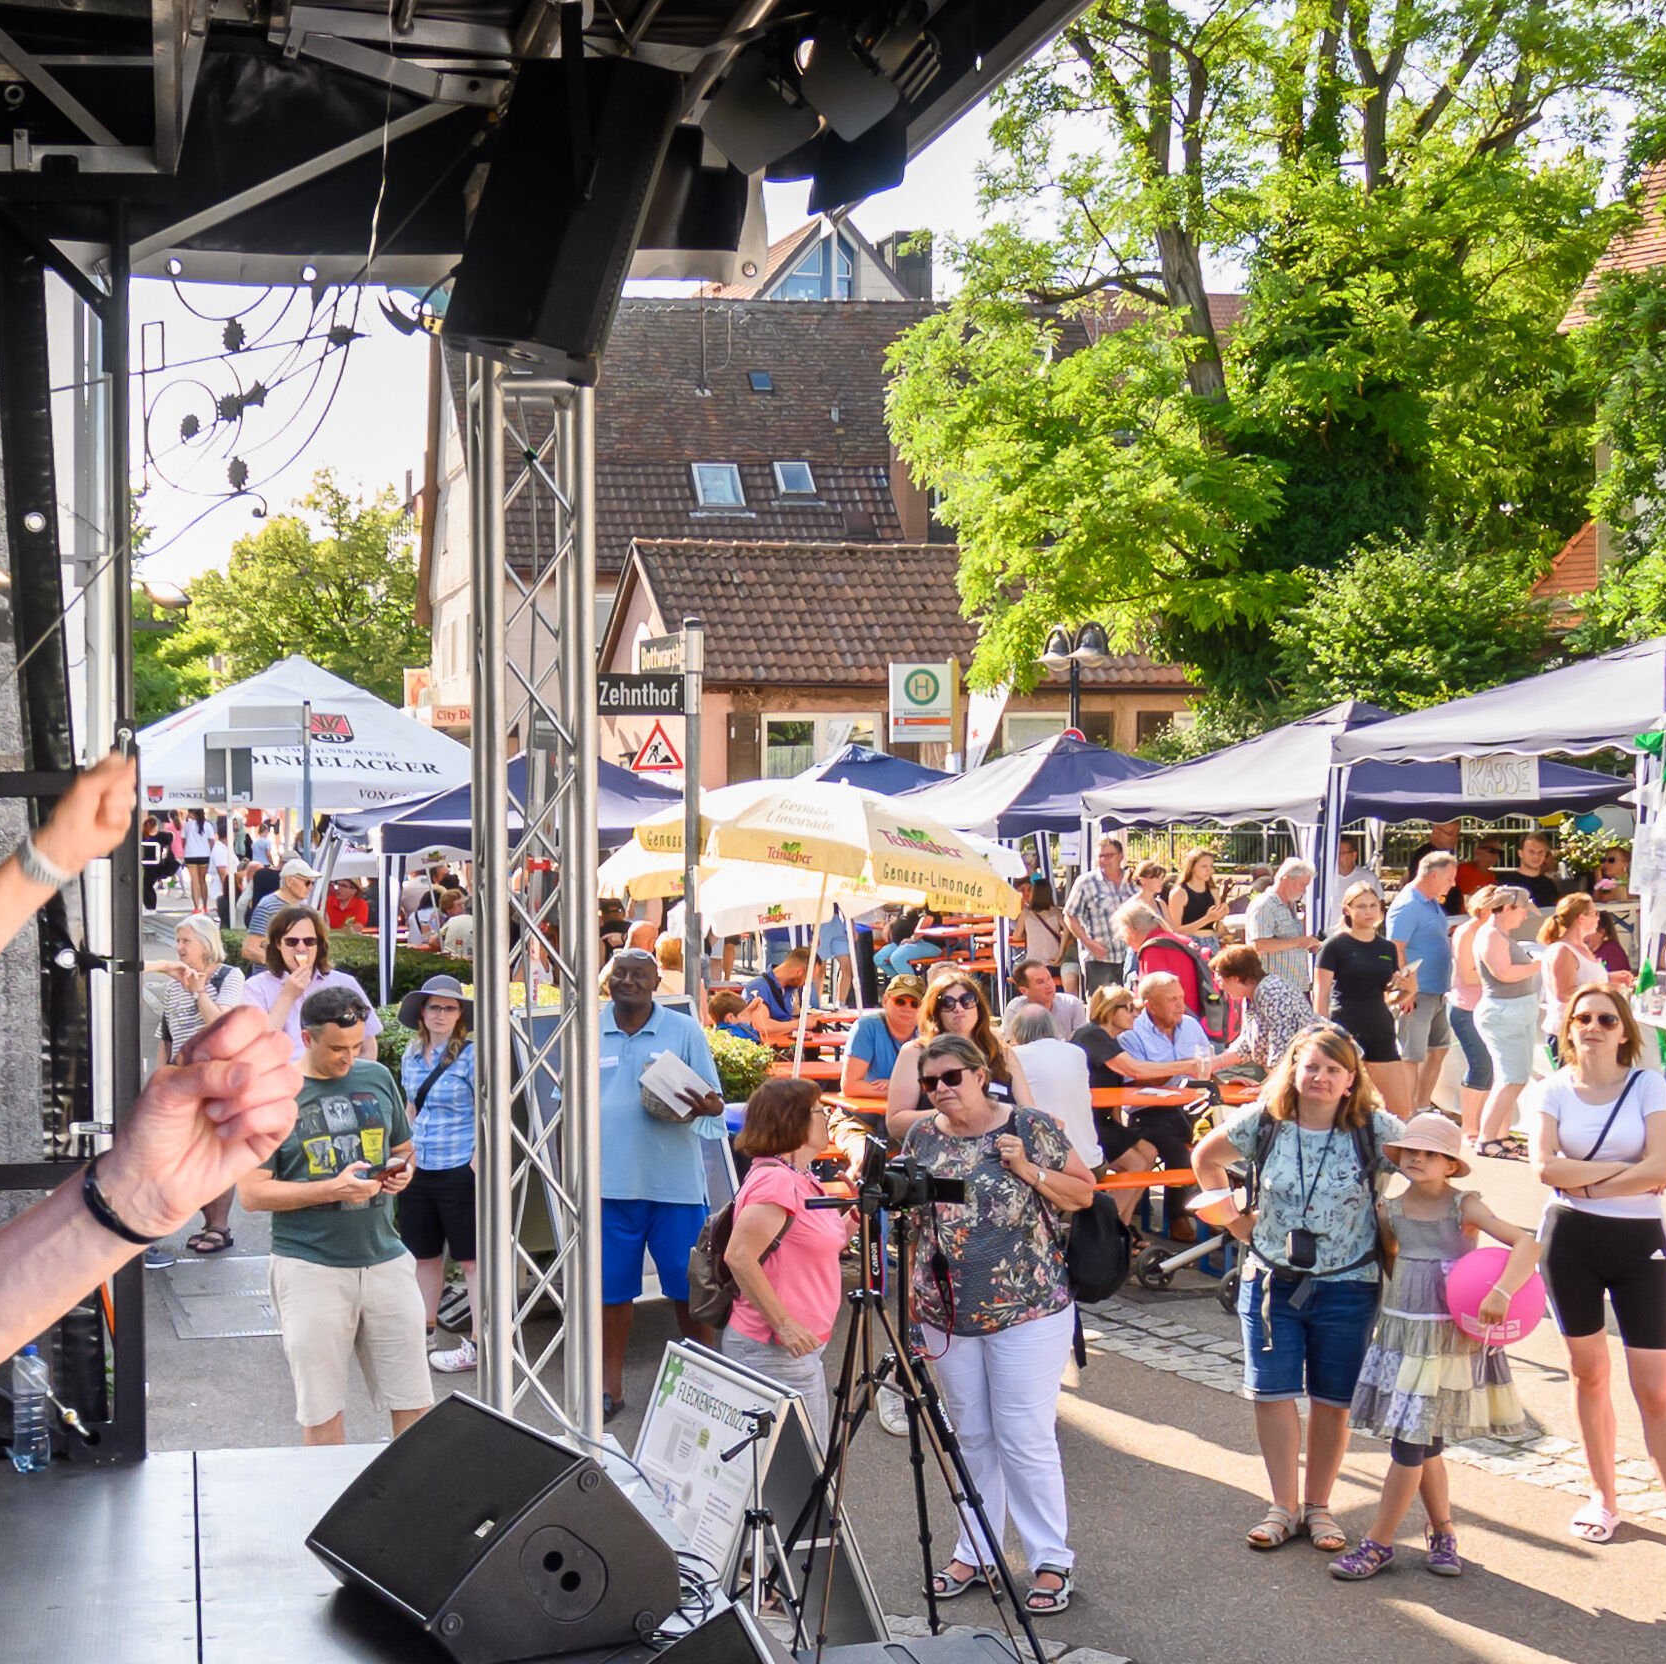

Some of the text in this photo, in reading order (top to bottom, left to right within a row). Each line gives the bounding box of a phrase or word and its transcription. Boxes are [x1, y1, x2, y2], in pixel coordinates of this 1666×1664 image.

[598, 680, 678, 707] Zehnthof
[436, 709, 456, 722] City
[1468, 758, 1532, 798] KASSE
[883, 861, 983, 897] Genuss-Limonade
[871, 1242, 880, 1276] Canon
[676, 1380, 744, 1432] FLECKENFEST2022
